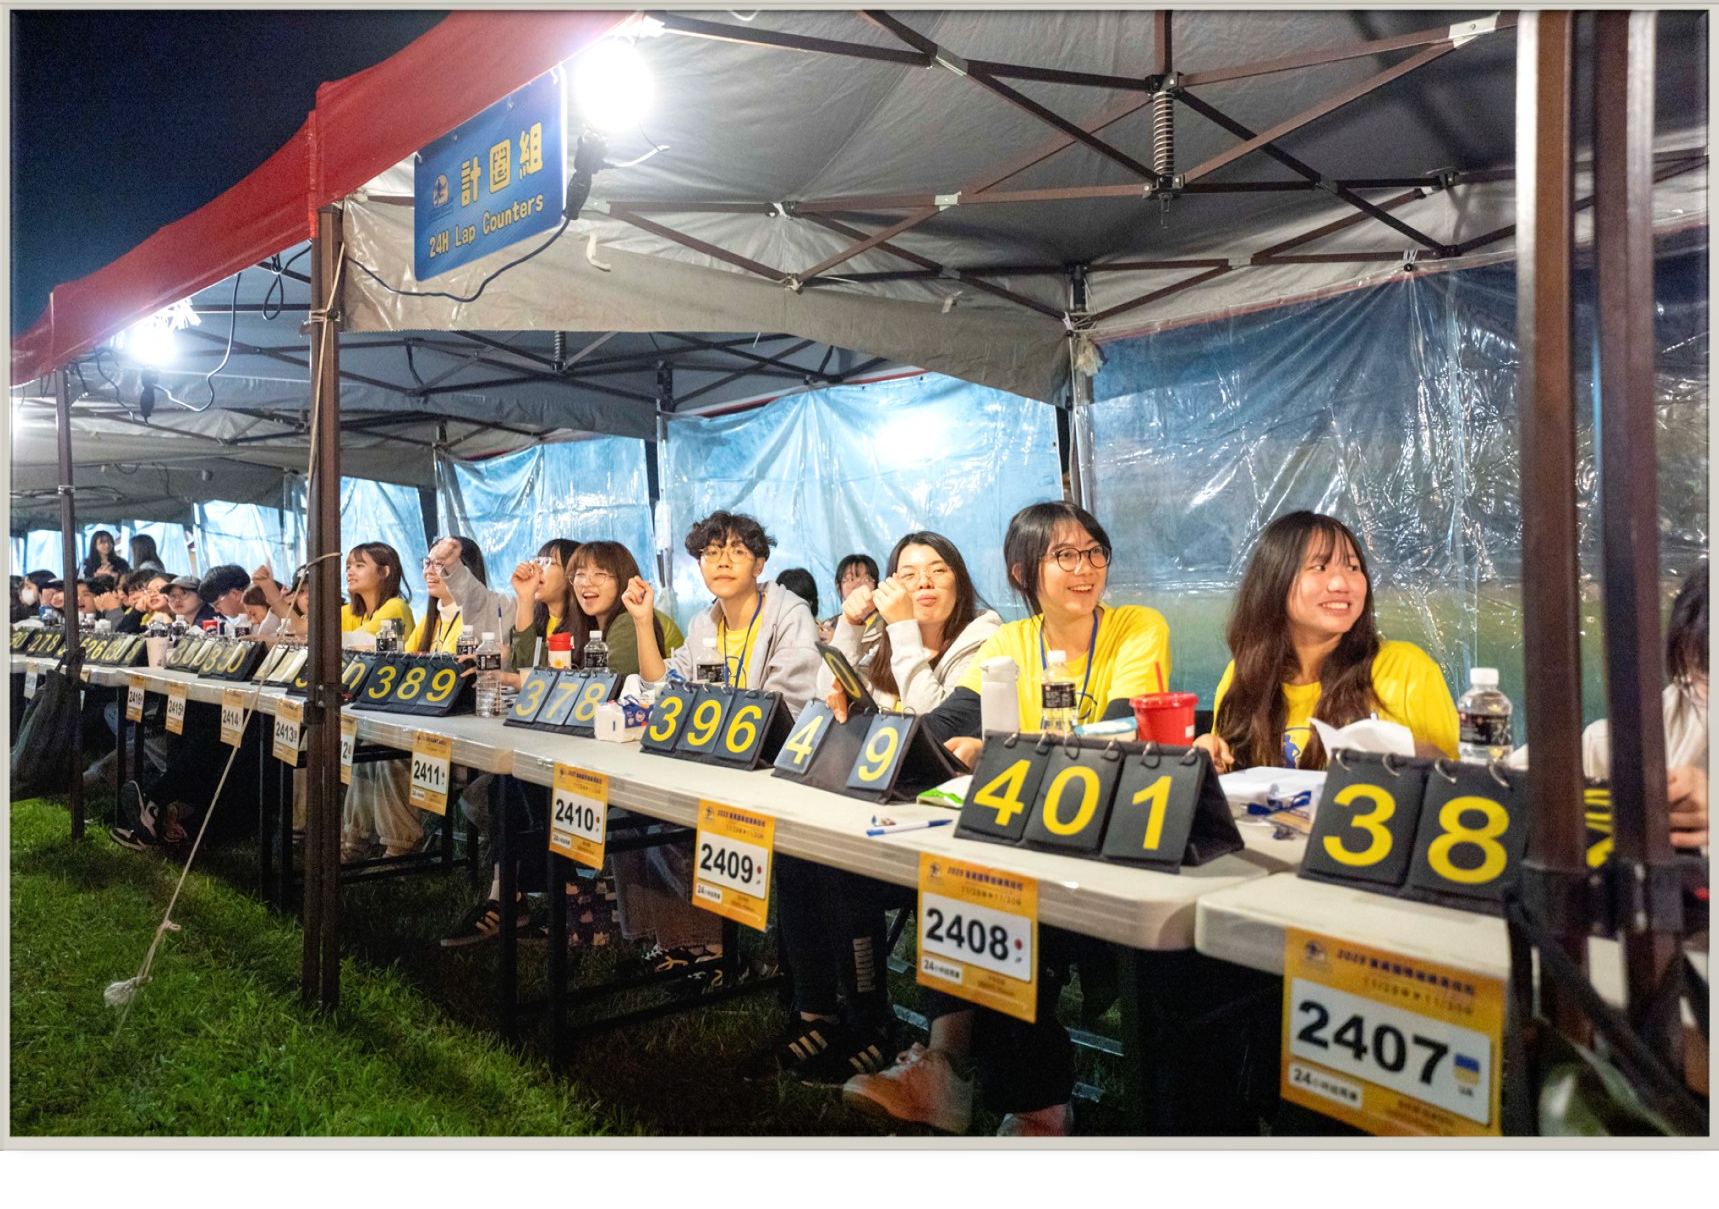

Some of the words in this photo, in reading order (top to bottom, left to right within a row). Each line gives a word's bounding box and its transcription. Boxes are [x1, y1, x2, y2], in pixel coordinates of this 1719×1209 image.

[461, 122, 543, 207] 計圈組
[429, 229, 449, 258] 24H
[455, 225, 476, 247] Lap
[483, 194, 544, 234] Counters
[368, 666, 457, 702] 389
[516, 679, 606, 721] 378
[223, 710, 239, 726] 2414
[276, 721, 294, 742] 2413
[649, 696, 762, 753] 396
[414, 760, 440, 785] 2411
[555, 798, 594, 831] 2410
[974, 759, 1172, 851] 401
[1323, 784, 1510, 884] 38
[700, 843, 753, 883] 2409
[926, 907, 1009, 961] 2408
[1297, 999, 1449, 1085] 2407
